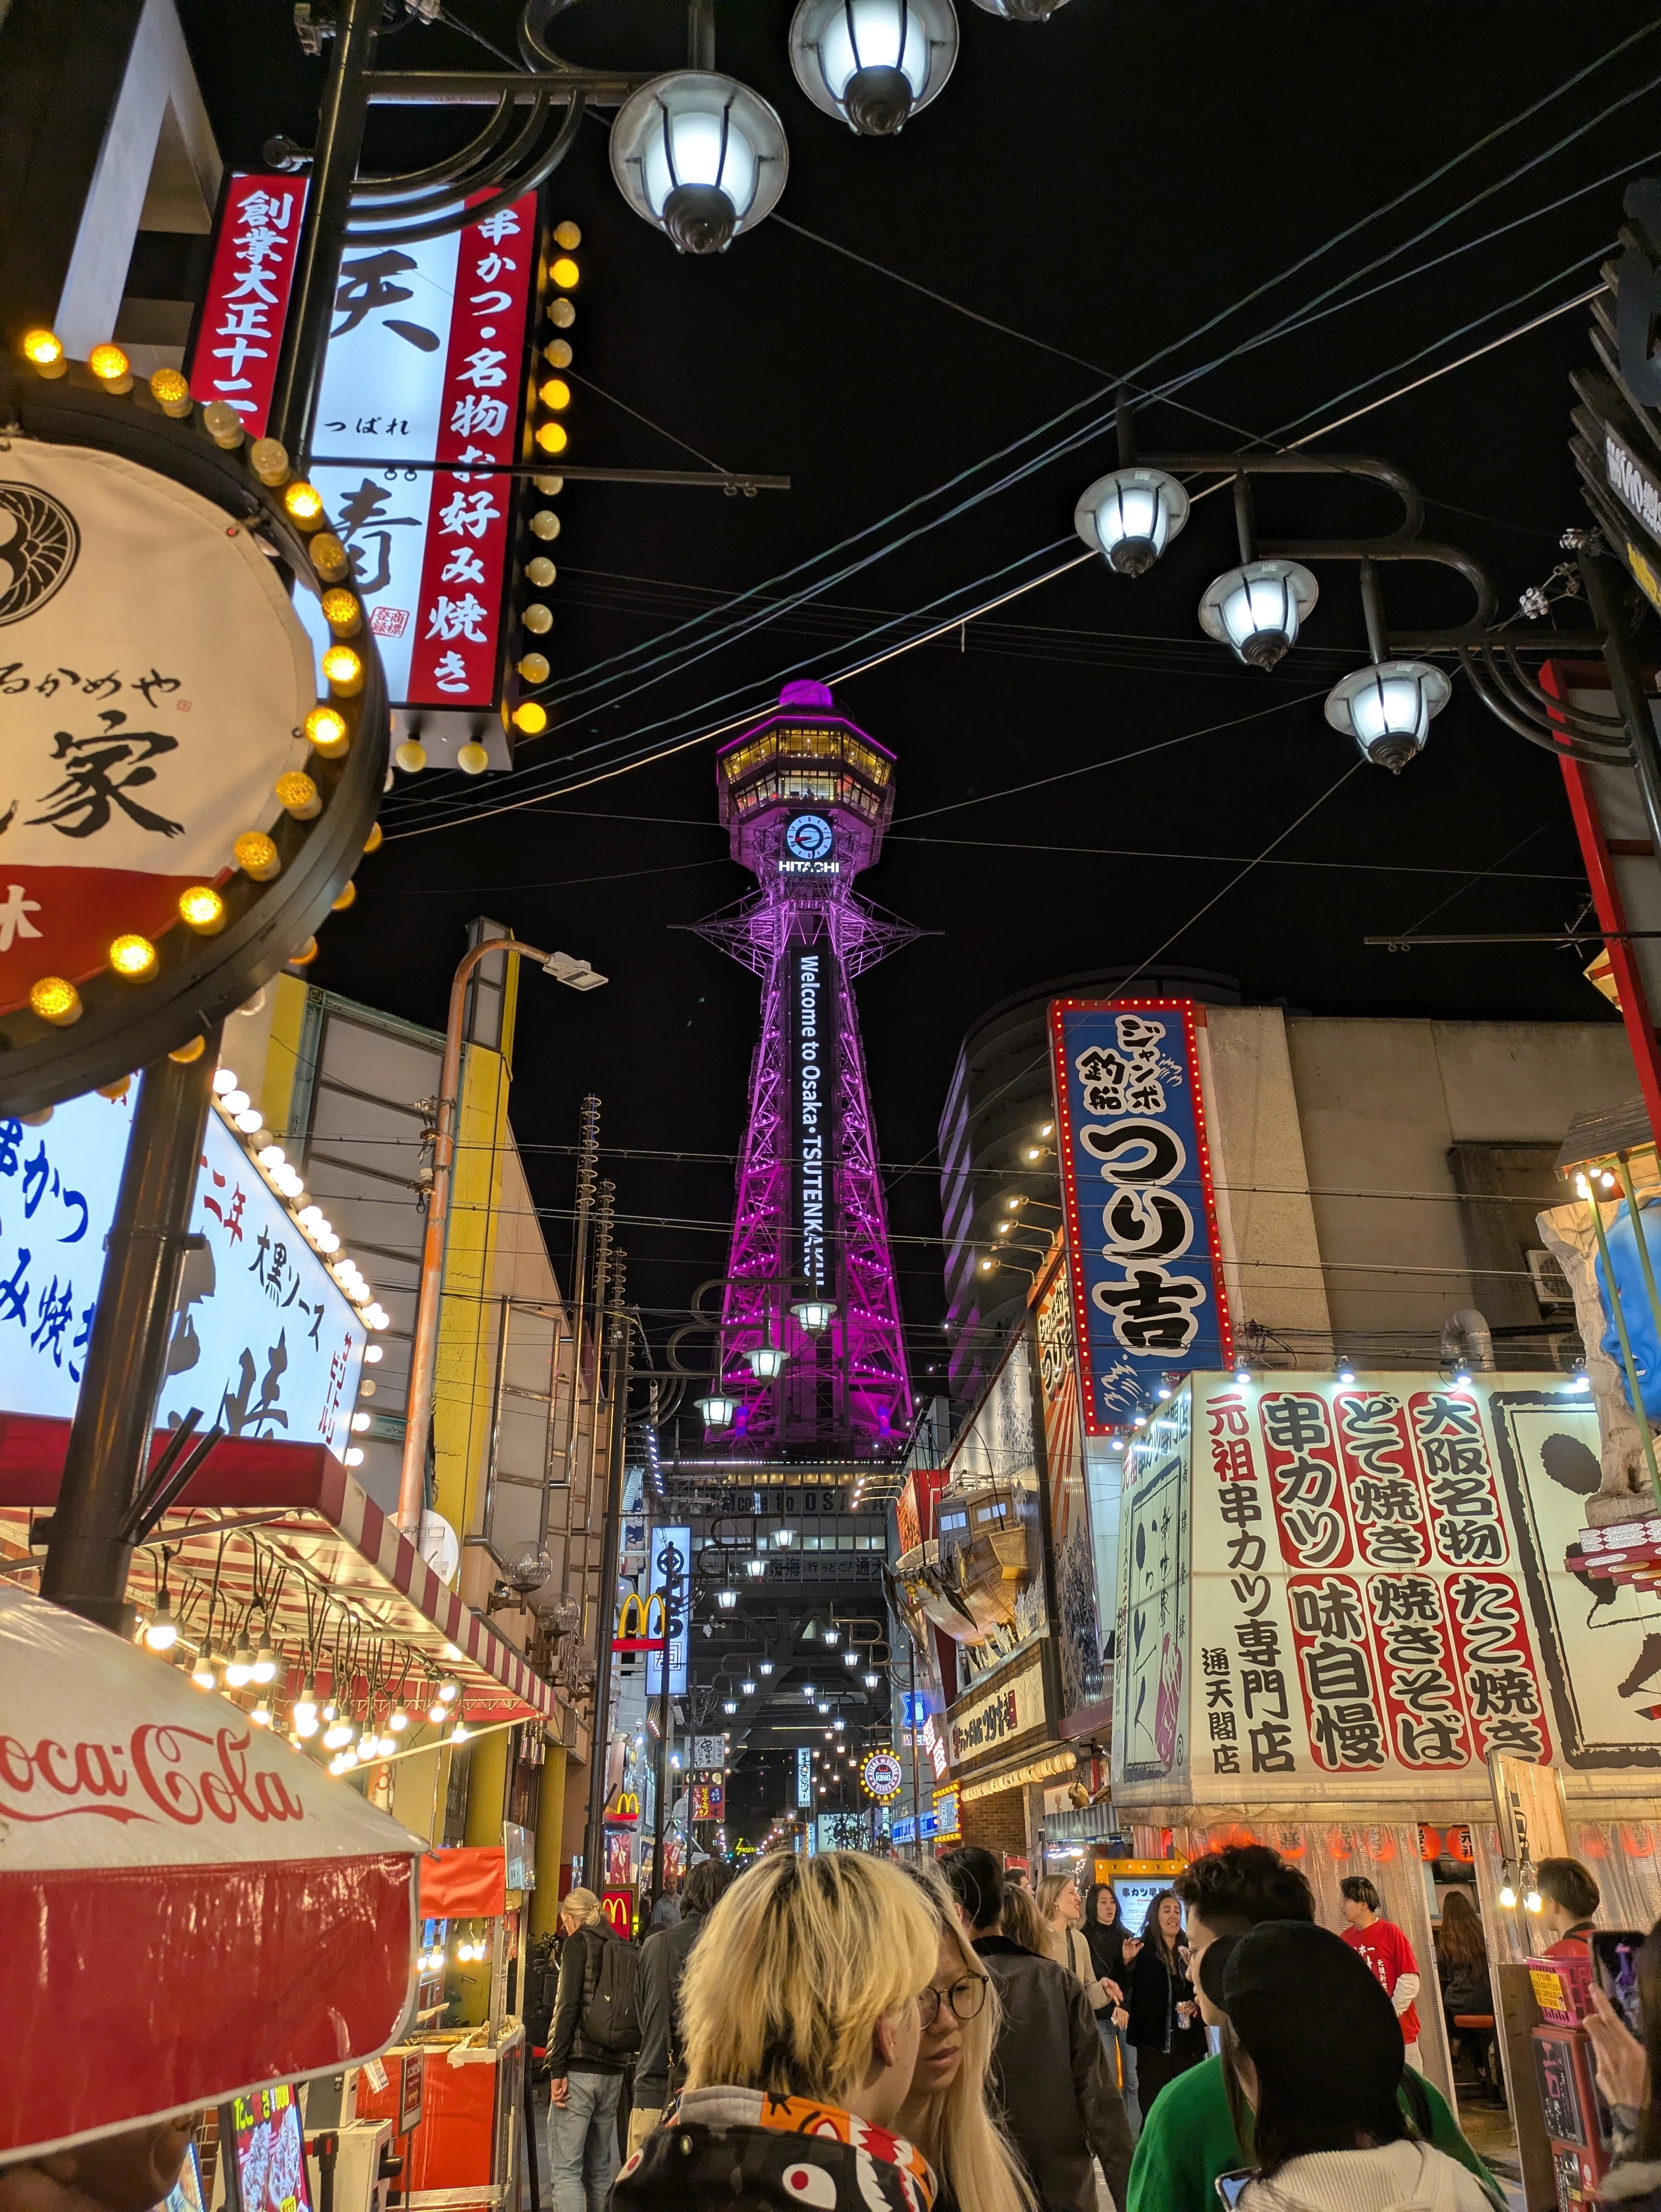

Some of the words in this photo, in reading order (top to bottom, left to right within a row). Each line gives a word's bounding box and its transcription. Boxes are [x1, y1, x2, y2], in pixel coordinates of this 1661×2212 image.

[778, 860, 840, 874] HITACHI
[800, 955, 820, 1037] Welcome
[802, 1041, 819, 1061] to
[802, 1065, 822, 1125] Osaka
[1078, 1049, 1127, 1112] 釣船
[1118, 1017, 1163, 1112] ジャンボ
[248, 1224, 325, 1354] 大黒ソース
[1083, 1121, 1202, 1352] つり吉
[1264, 1399, 1344, 1562] 串カツ
[1342, 1396, 1425, 1565] どて焼き
[1416, 1397, 1502, 1561] 大阪名物
[1205, 1393, 1296, 1773] 元祖串カツ専門店
[1200, 1646, 1241, 1775] 通天閣店
[1292, 1584, 1385, 1767] 味自慢
[1372, 1579, 1466, 1761] 焼きそば
[1453, 1578, 1543, 1763] たこ焼き
[867, 1758, 880, 1776] STEAK
[886, 1758, 899, 1775] HOUSE
[875, 1784, 892, 1792] OSAKA
